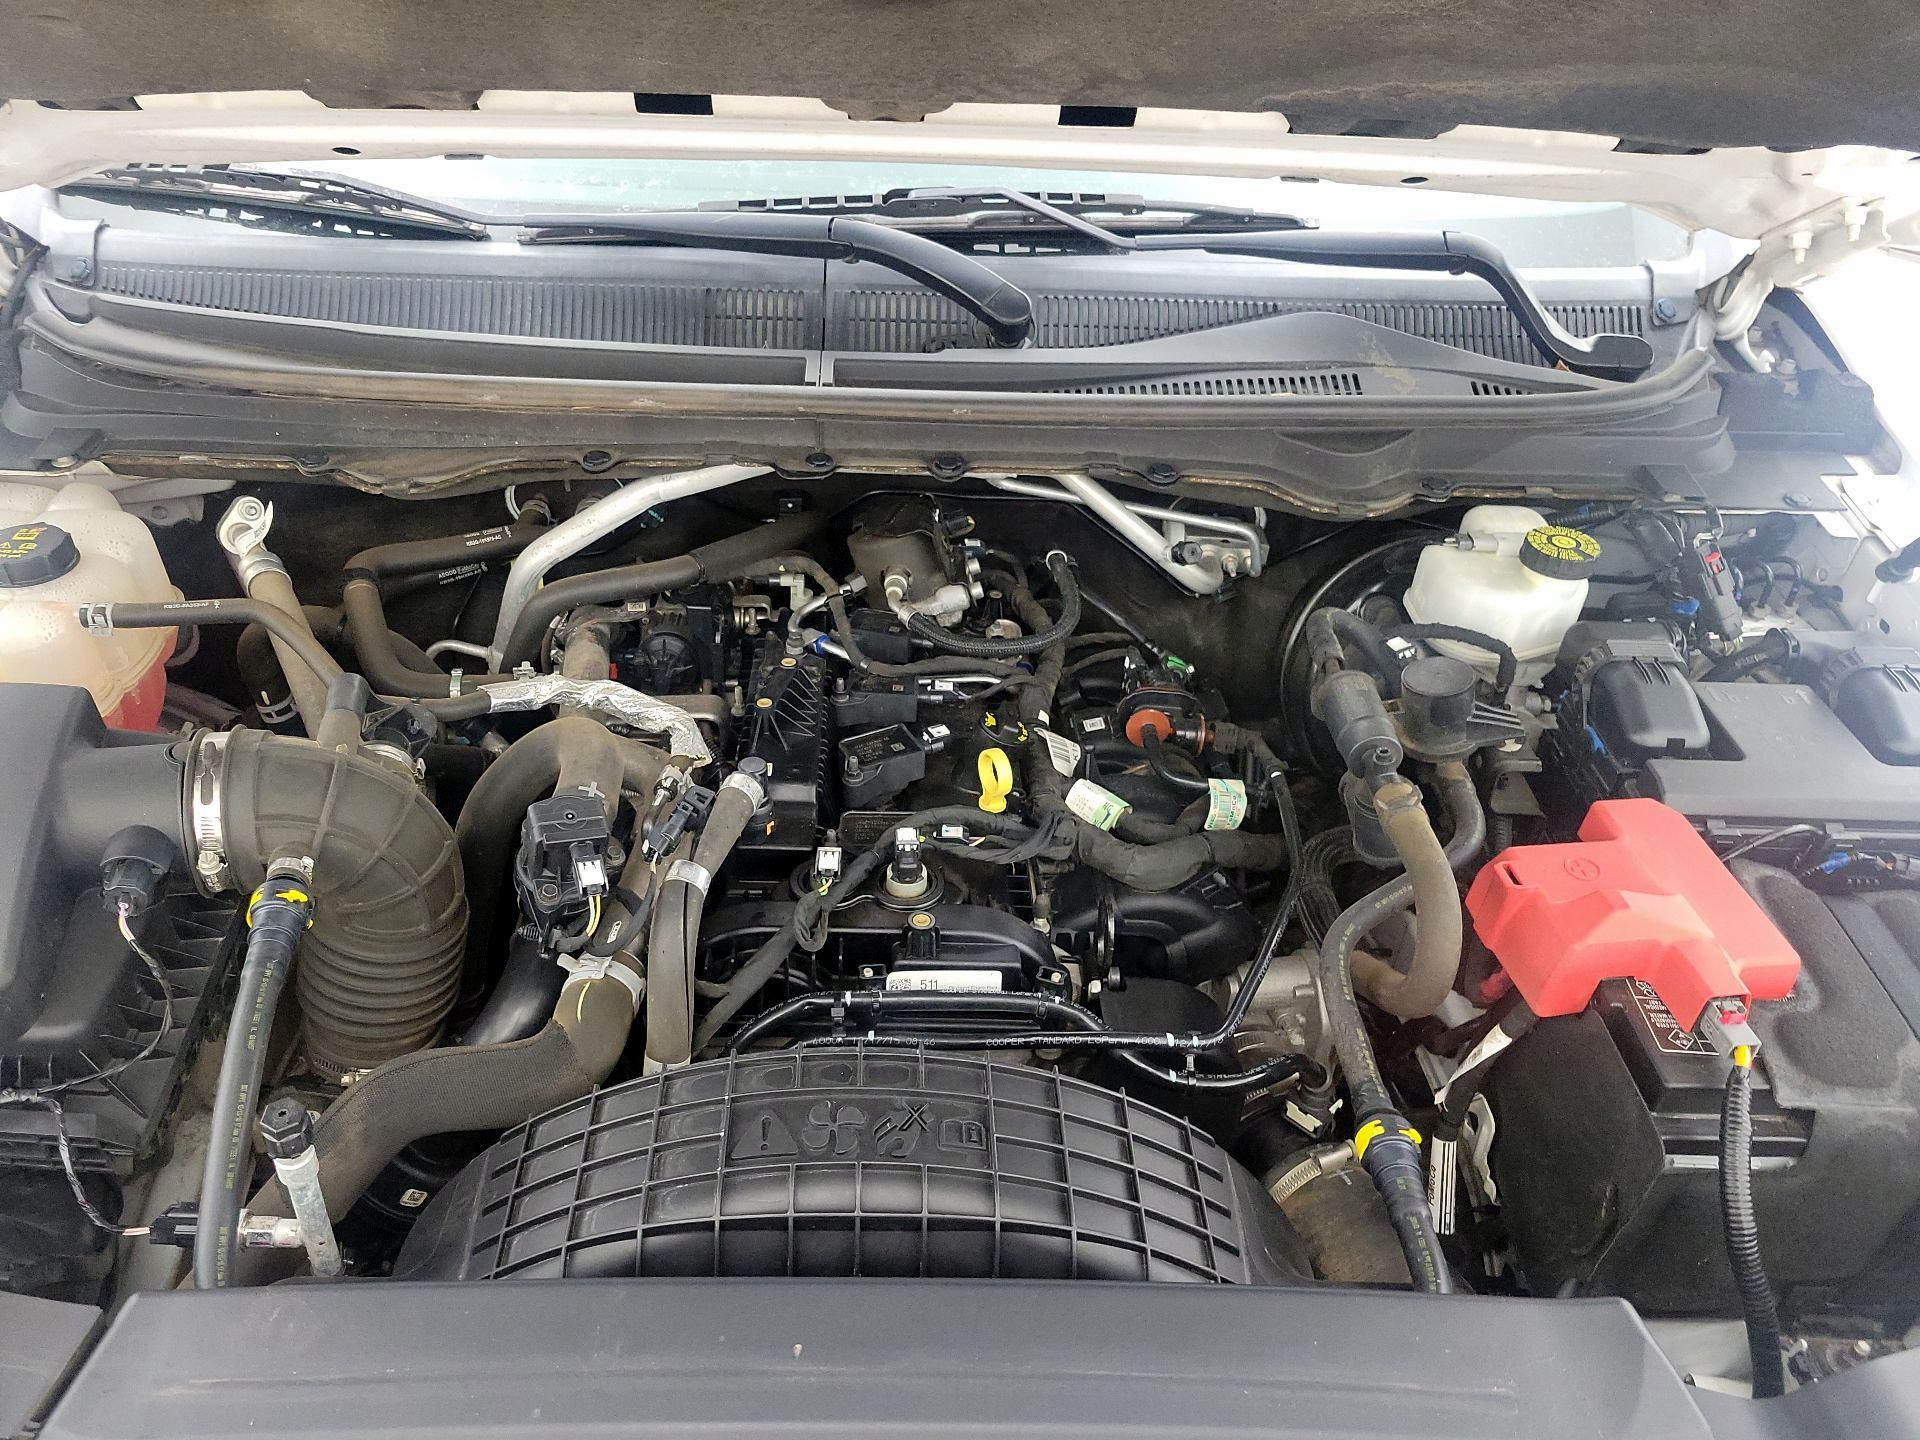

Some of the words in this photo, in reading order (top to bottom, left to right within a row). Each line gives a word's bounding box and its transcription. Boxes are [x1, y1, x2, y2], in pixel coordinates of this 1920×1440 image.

[920, 979, 938, 990] 511
[986, 1038, 1025, 1047] COOPER
[1031, 1036, 1082, 1046] STANDARD
